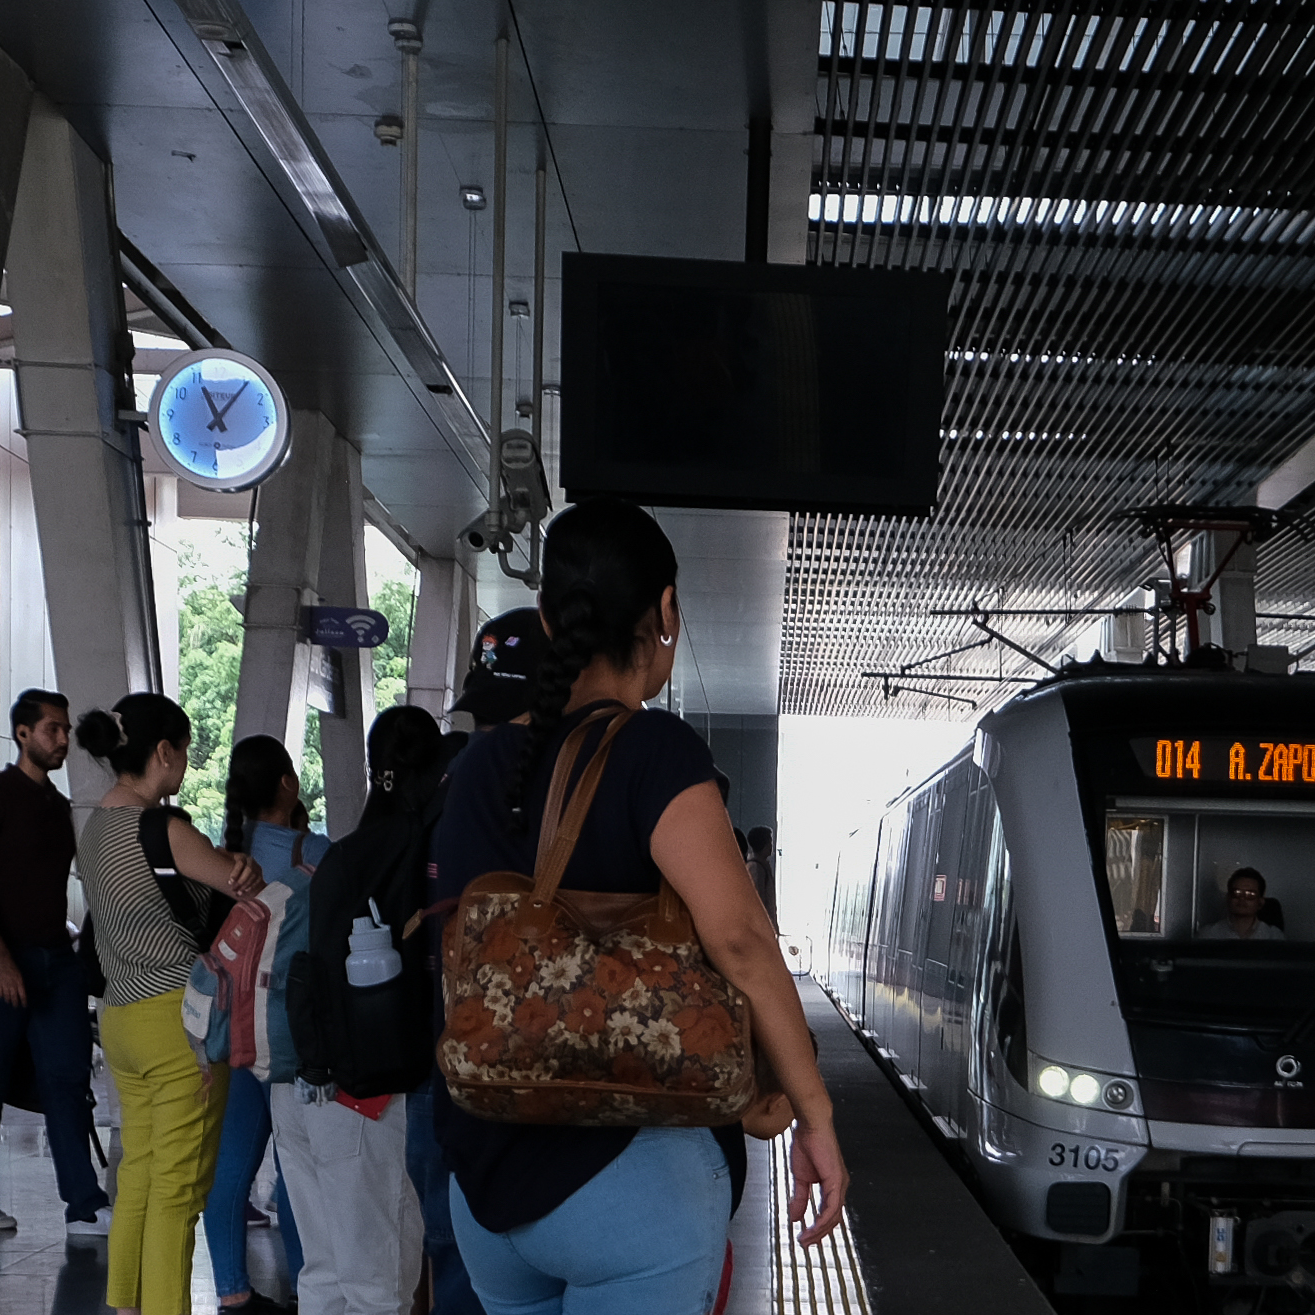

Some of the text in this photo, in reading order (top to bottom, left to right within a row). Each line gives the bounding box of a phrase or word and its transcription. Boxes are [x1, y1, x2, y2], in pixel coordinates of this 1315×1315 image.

[192, 372, 201, 384] 11
[175, 387, 187, 400] 10
[257, 392, 264, 406] 2
[166, 408, 175, 421] 9
[262, 415, 270, 429] 3
[172, 432, 181, 445] 8
[190, 450, 197, 463] 7
[1048, 1142, 1119, 1172] 3105
